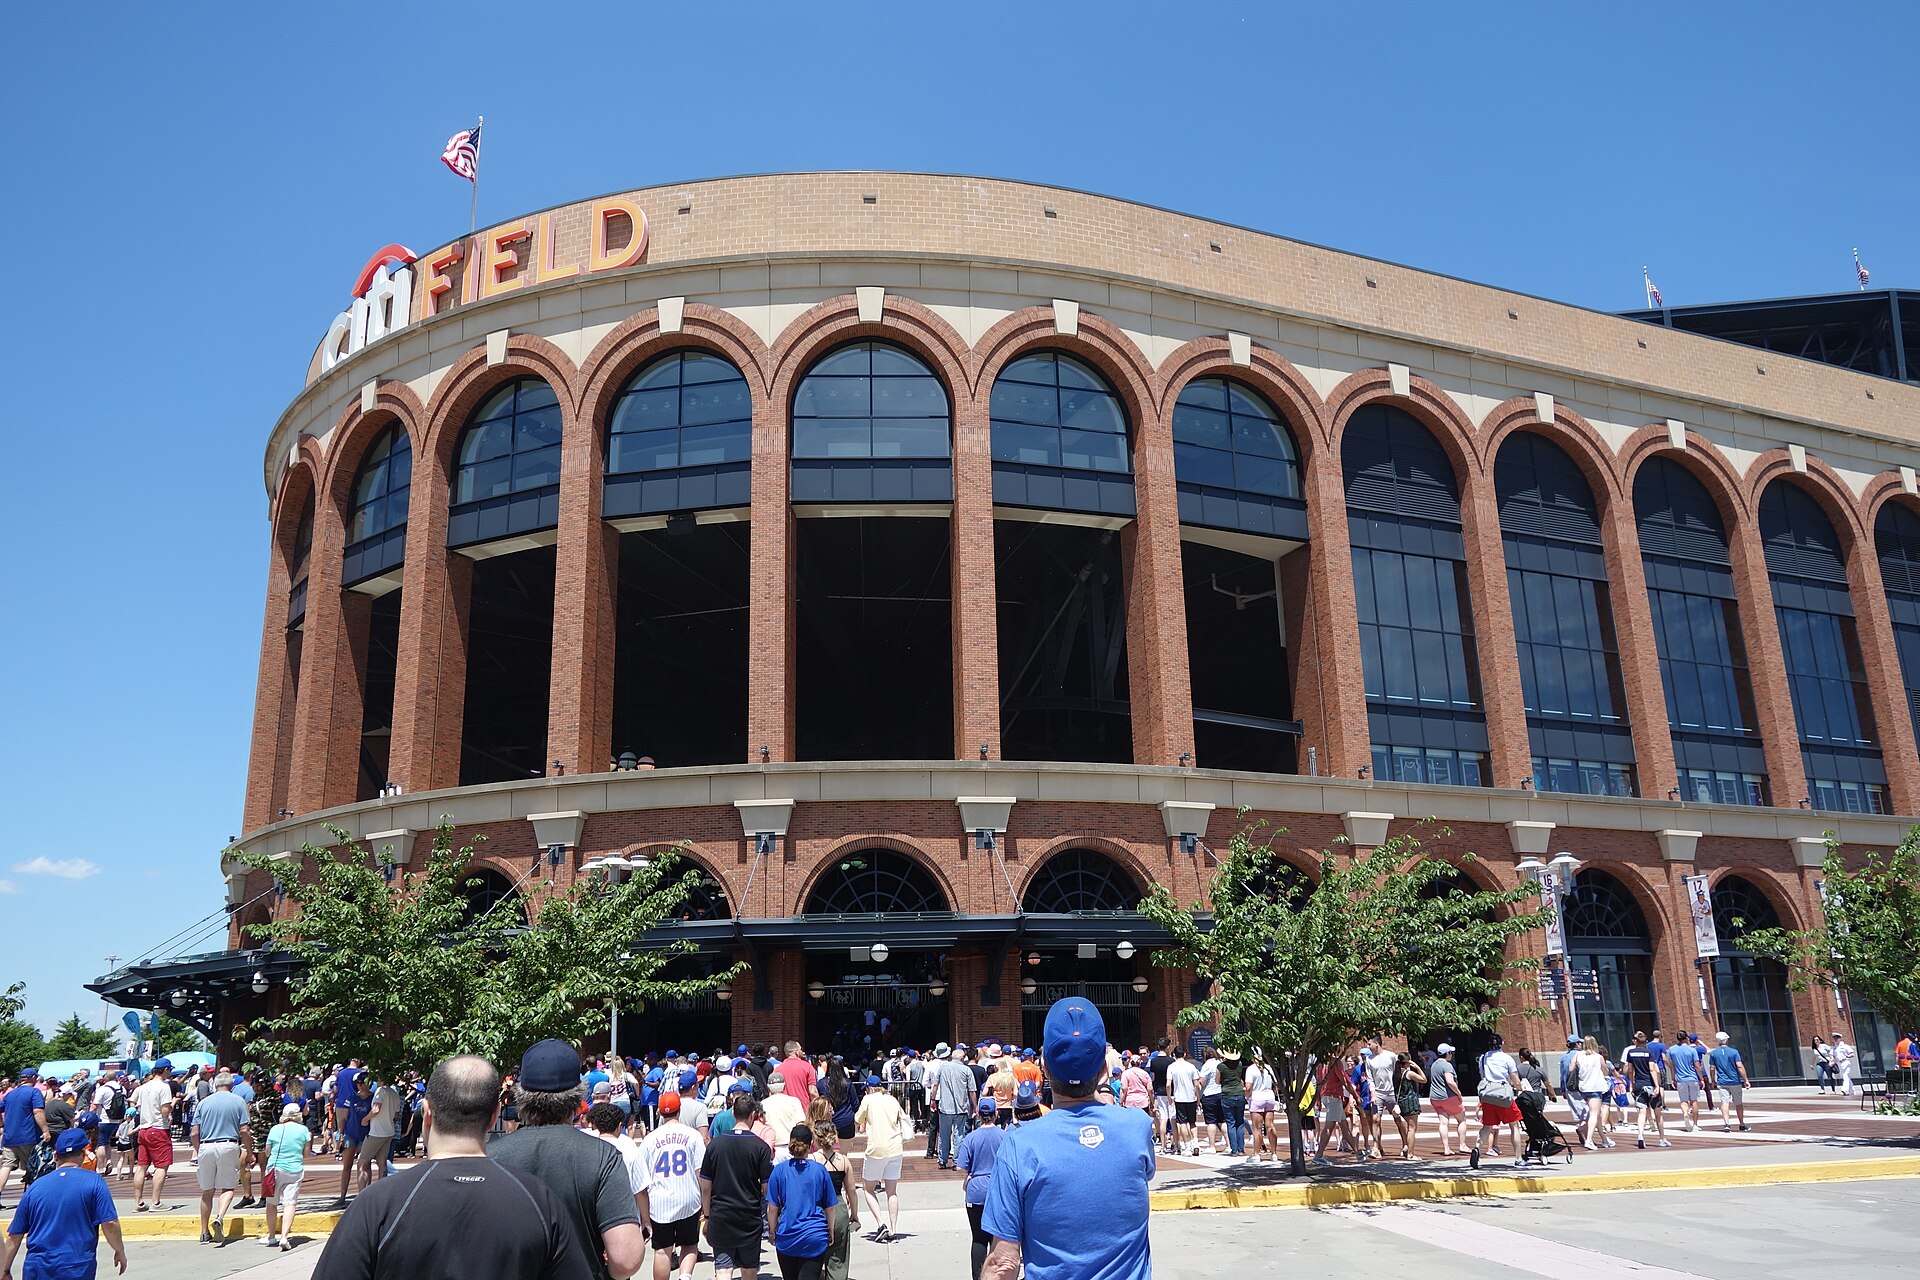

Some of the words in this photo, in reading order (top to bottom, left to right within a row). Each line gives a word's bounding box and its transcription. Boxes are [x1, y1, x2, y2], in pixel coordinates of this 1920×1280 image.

[420, 199, 649, 320] FIELD
[1543, 873, 1553, 886] 16
[1693, 880, 1703, 892] 17
[655, 1132, 690, 1149] deGROM
[655, 1149, 688, 1178] 48
